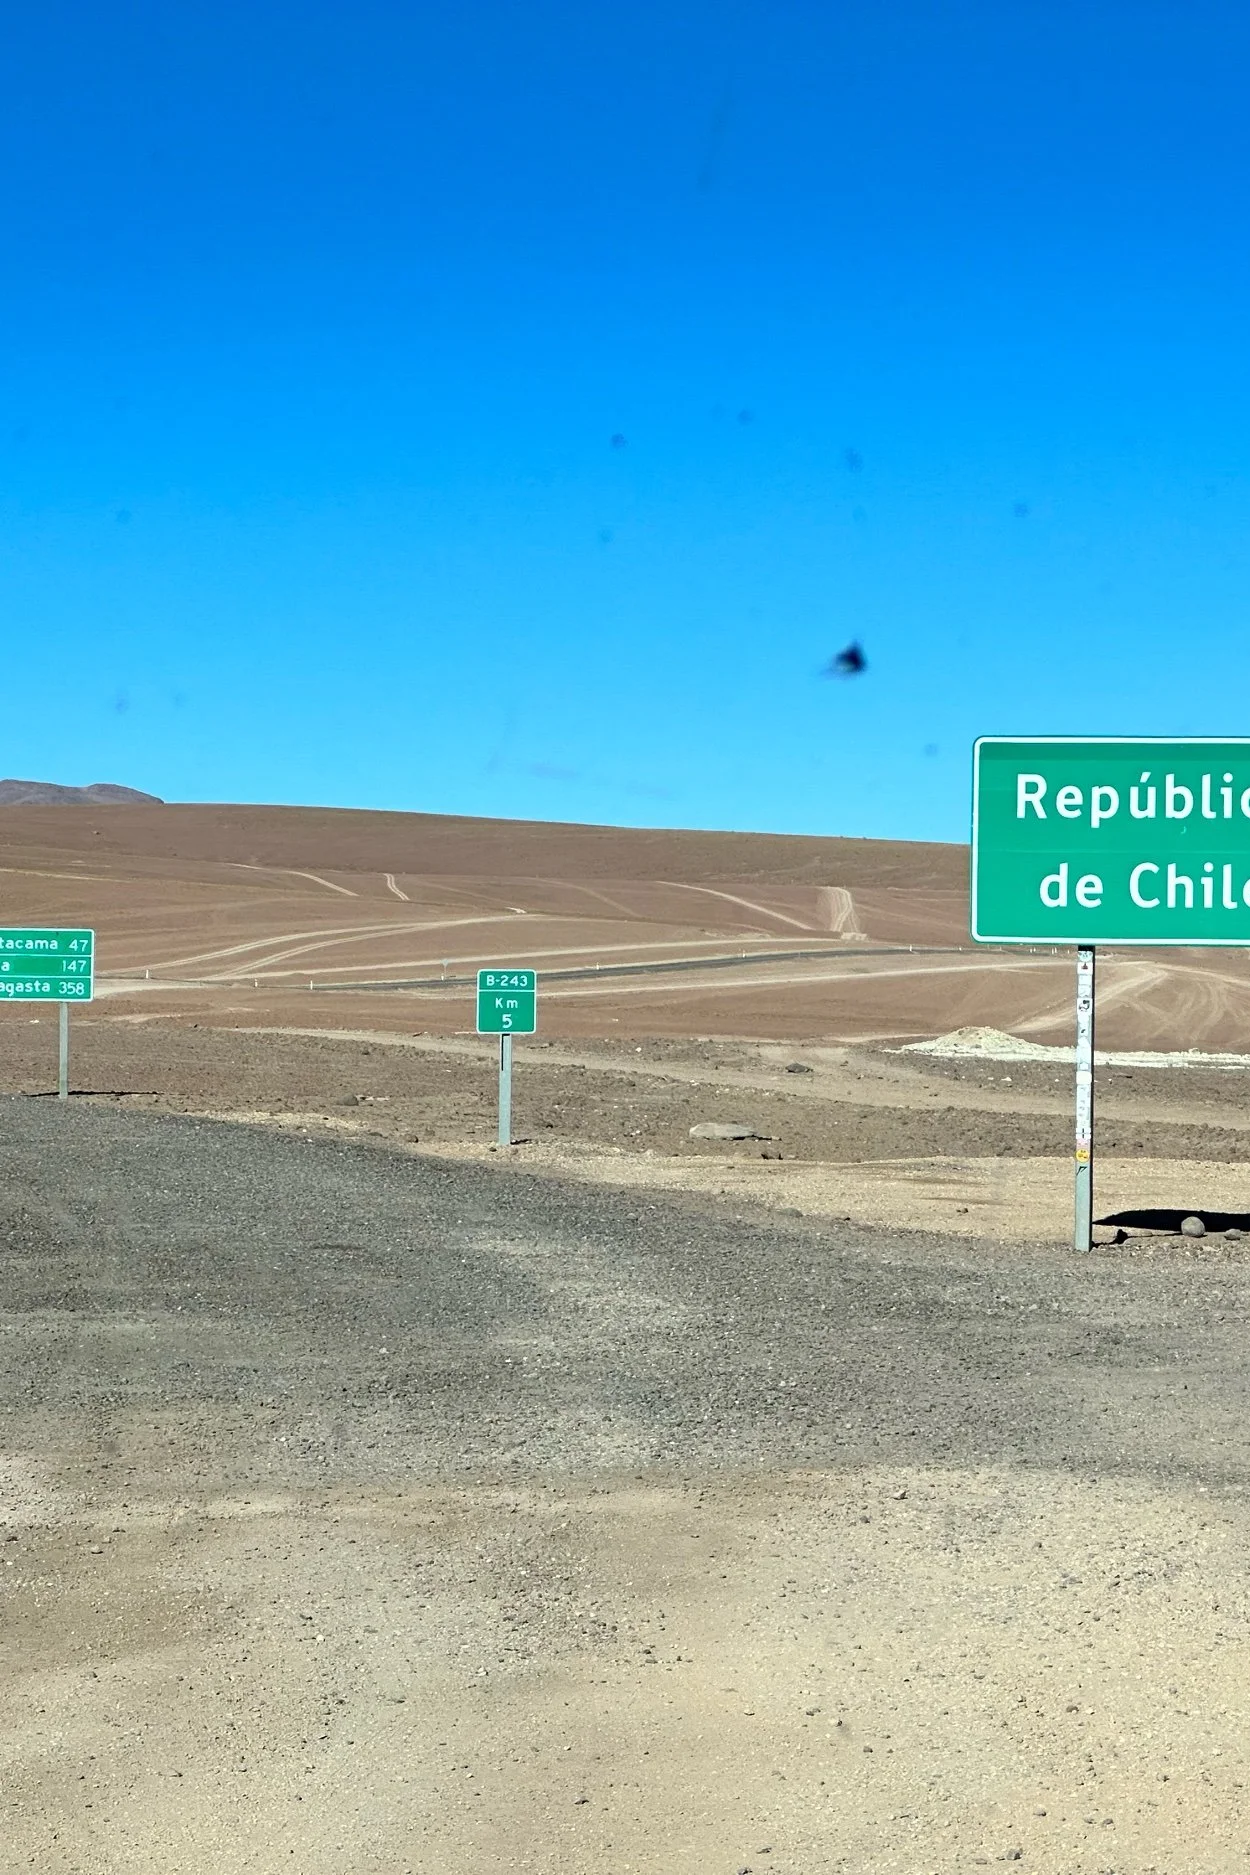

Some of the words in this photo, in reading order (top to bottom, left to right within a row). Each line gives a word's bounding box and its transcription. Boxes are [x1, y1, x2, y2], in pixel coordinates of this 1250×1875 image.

[1039, 862, 1104, 908] de
[68, 939, 89, 952] 47
[62, 960, 87, 973] 147
[486, 974, 528, 987] B-243
[58, 981, 85, 996] 358
[495, 997, 519, 1009] Km
[501, 1013, 513, 1029] 5
